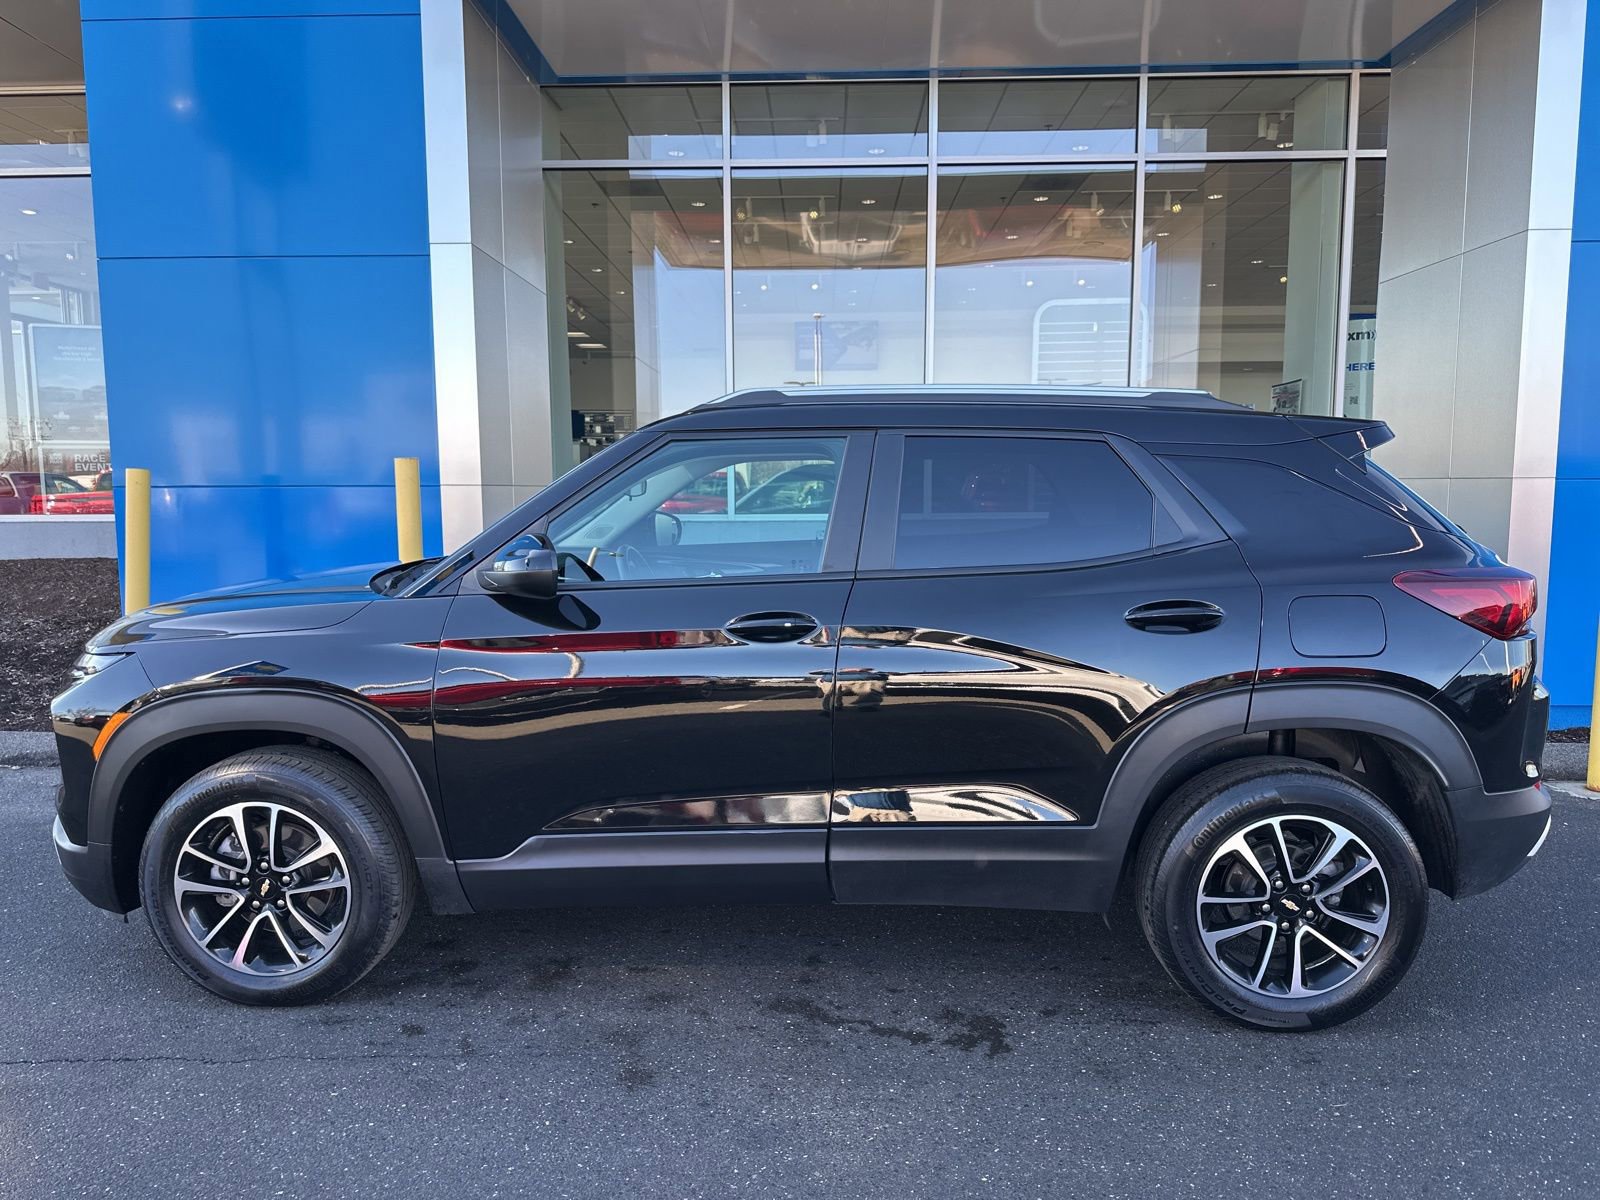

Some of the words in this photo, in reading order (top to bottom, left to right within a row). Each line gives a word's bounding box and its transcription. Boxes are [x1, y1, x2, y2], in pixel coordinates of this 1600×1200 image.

[74, 454, 106, 463] RACE
[75, 462, 113, 472] EVENT
[1191, 793, 1259, 850] Continental
